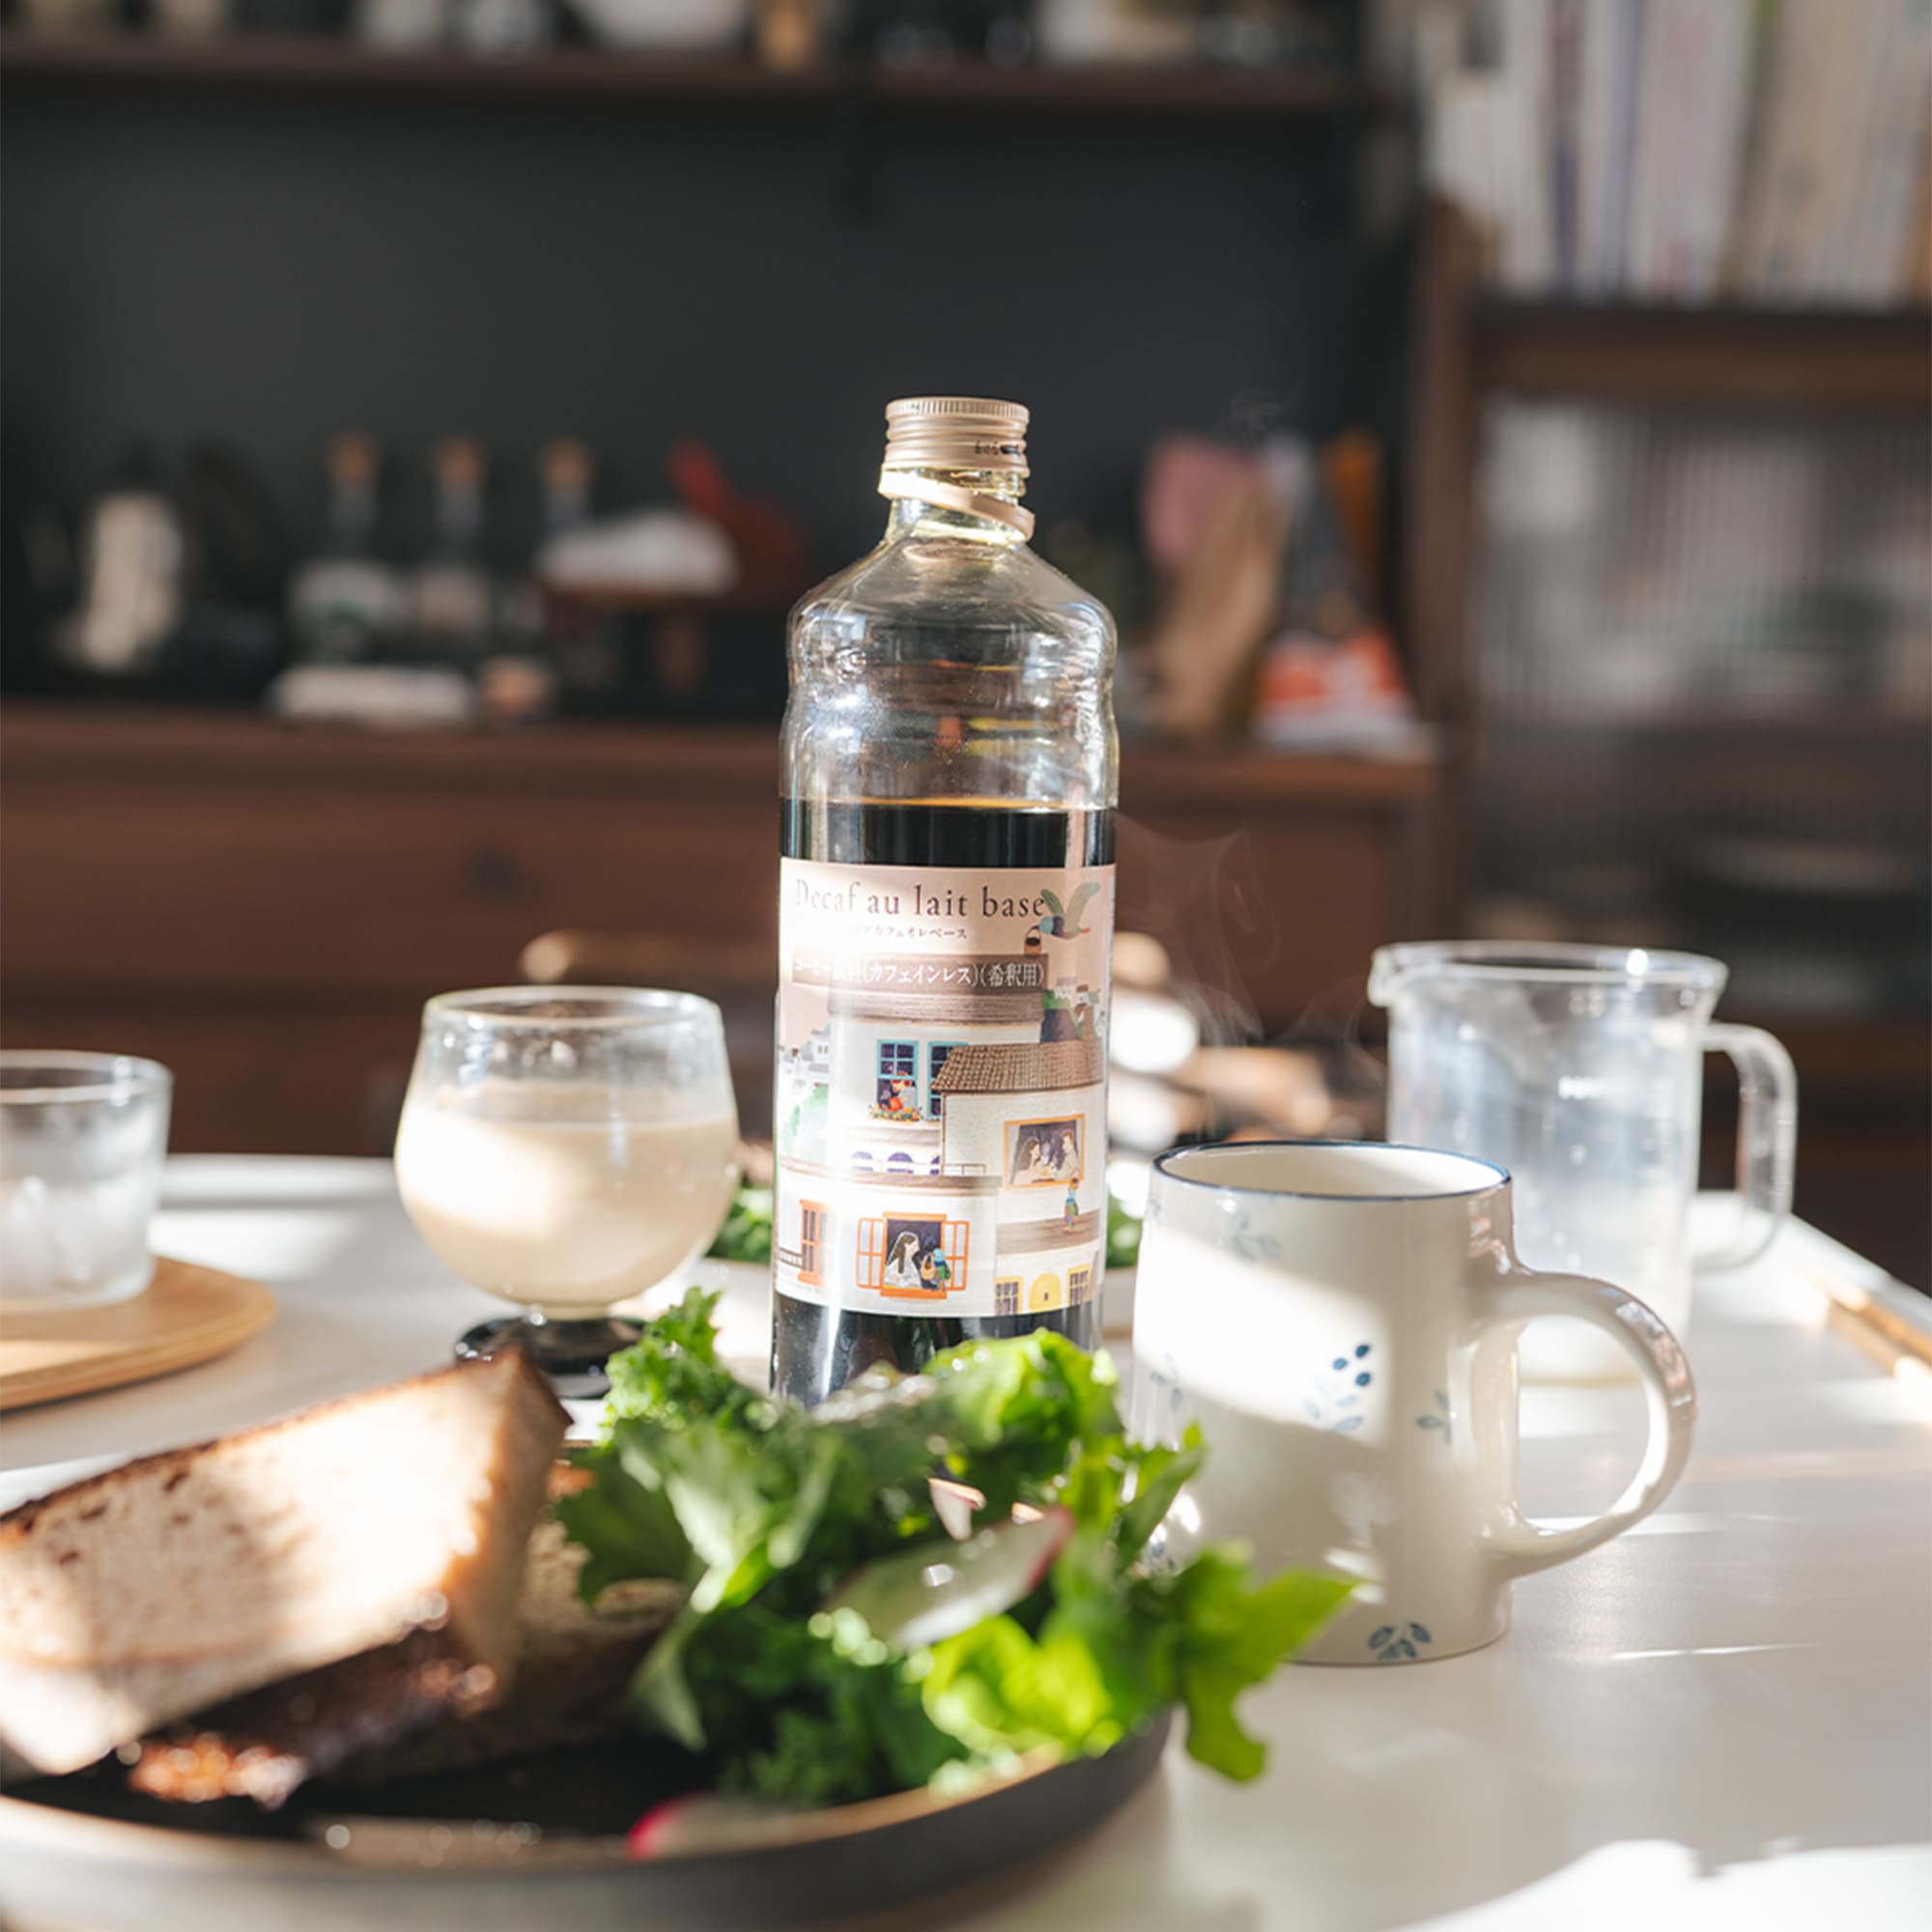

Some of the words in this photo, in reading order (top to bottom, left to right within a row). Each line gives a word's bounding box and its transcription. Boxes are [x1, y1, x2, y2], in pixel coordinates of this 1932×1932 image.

[795, 878, 861, 912] Decaf
[867, 895, 900, 916] au
[914, 884, 968, 917] lait
[981, 886, 1045, 917] base
[863, 924, 967, 940] カフェオレベース
